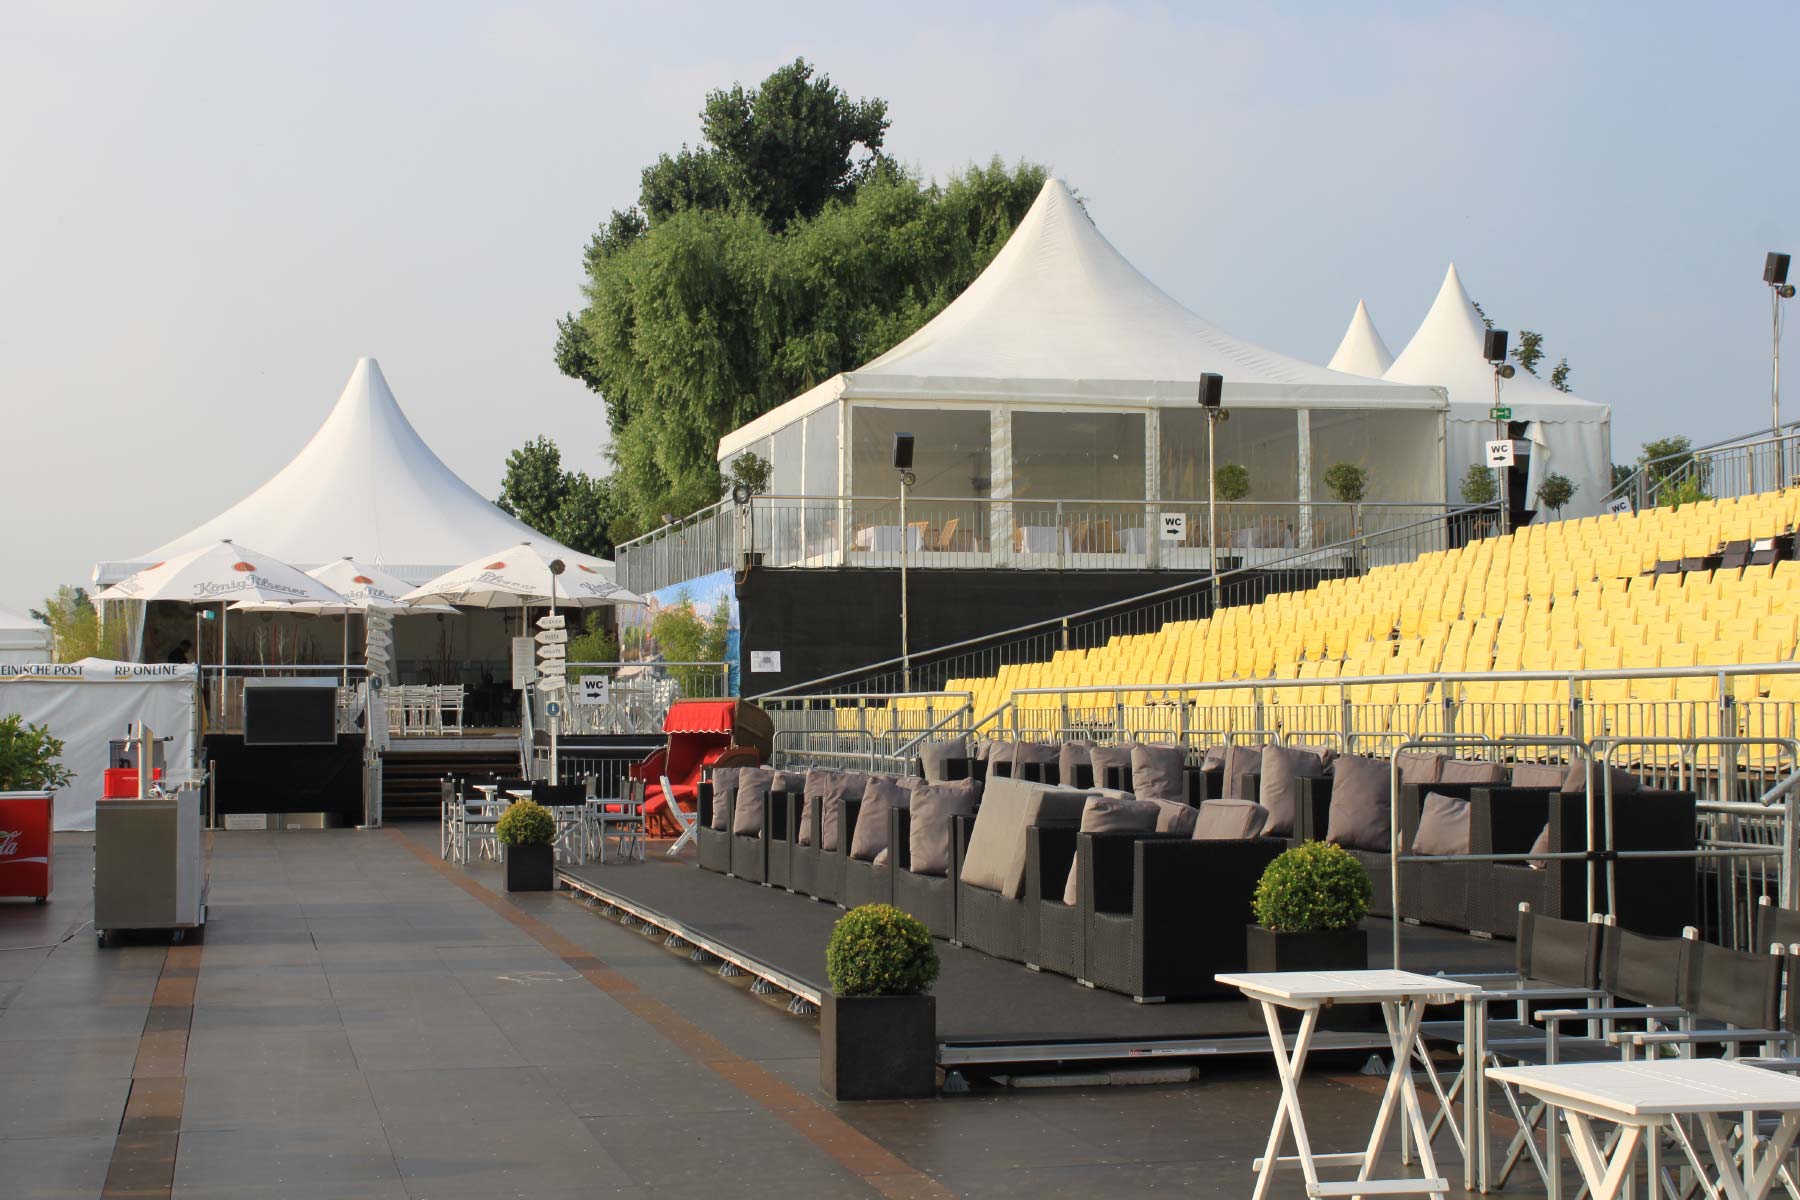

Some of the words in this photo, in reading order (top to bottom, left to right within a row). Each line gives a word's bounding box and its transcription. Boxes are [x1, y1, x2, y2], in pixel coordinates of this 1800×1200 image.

[1491, 444, 1508, 453] WC
[1611, 501, 1626, 513] WC
[1165, 517, 1182, 526] WC
[193, 580, 247, 597] König
[246, 574, 307, 596] Pilsener
[54, 665, 84, 676] POST
[115, 665, 131, 676] RP
[134, 664, 178, 676] ONLINE
[585, 680, 604, 689] WC
